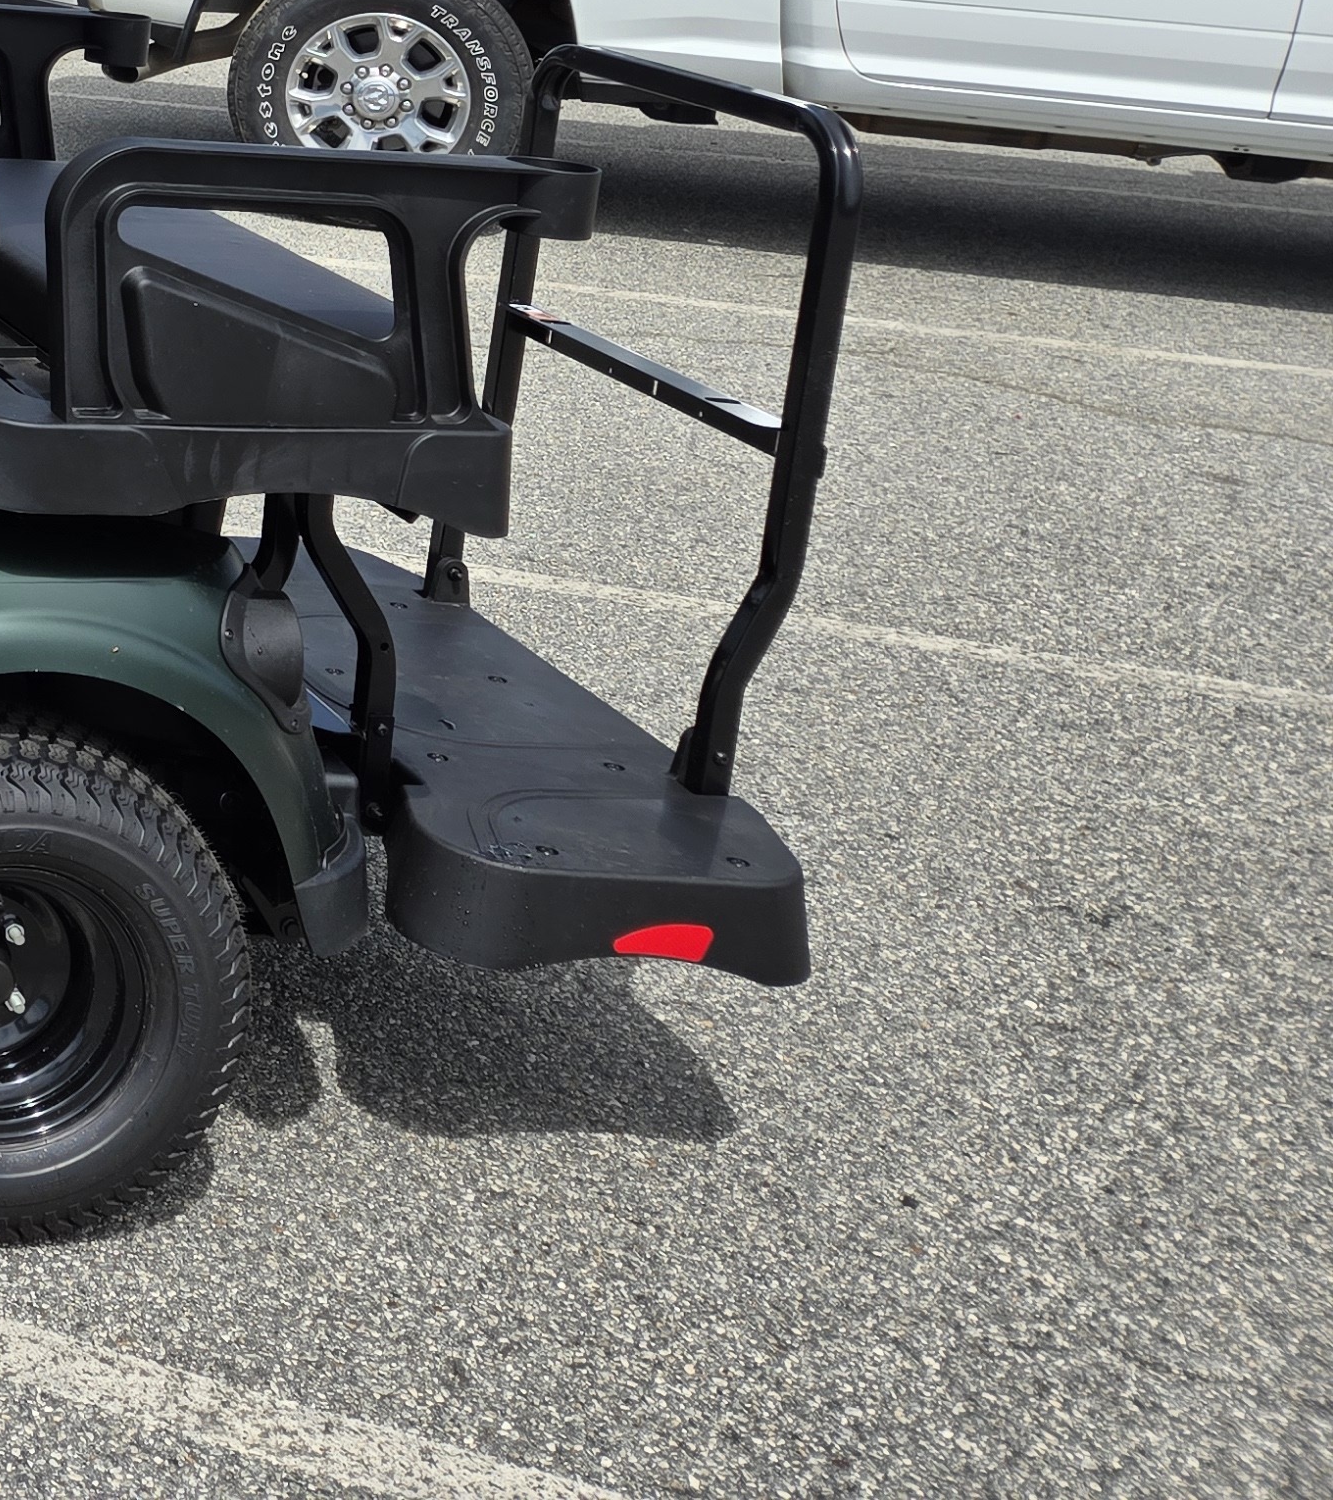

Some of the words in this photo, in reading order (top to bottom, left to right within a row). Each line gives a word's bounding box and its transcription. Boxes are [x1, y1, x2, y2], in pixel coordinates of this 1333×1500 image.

[257, 25, 298, 147] estone
[431, 4, 499, 147] TRANSFORCE
[132, 882, 197, 975] SUPER
